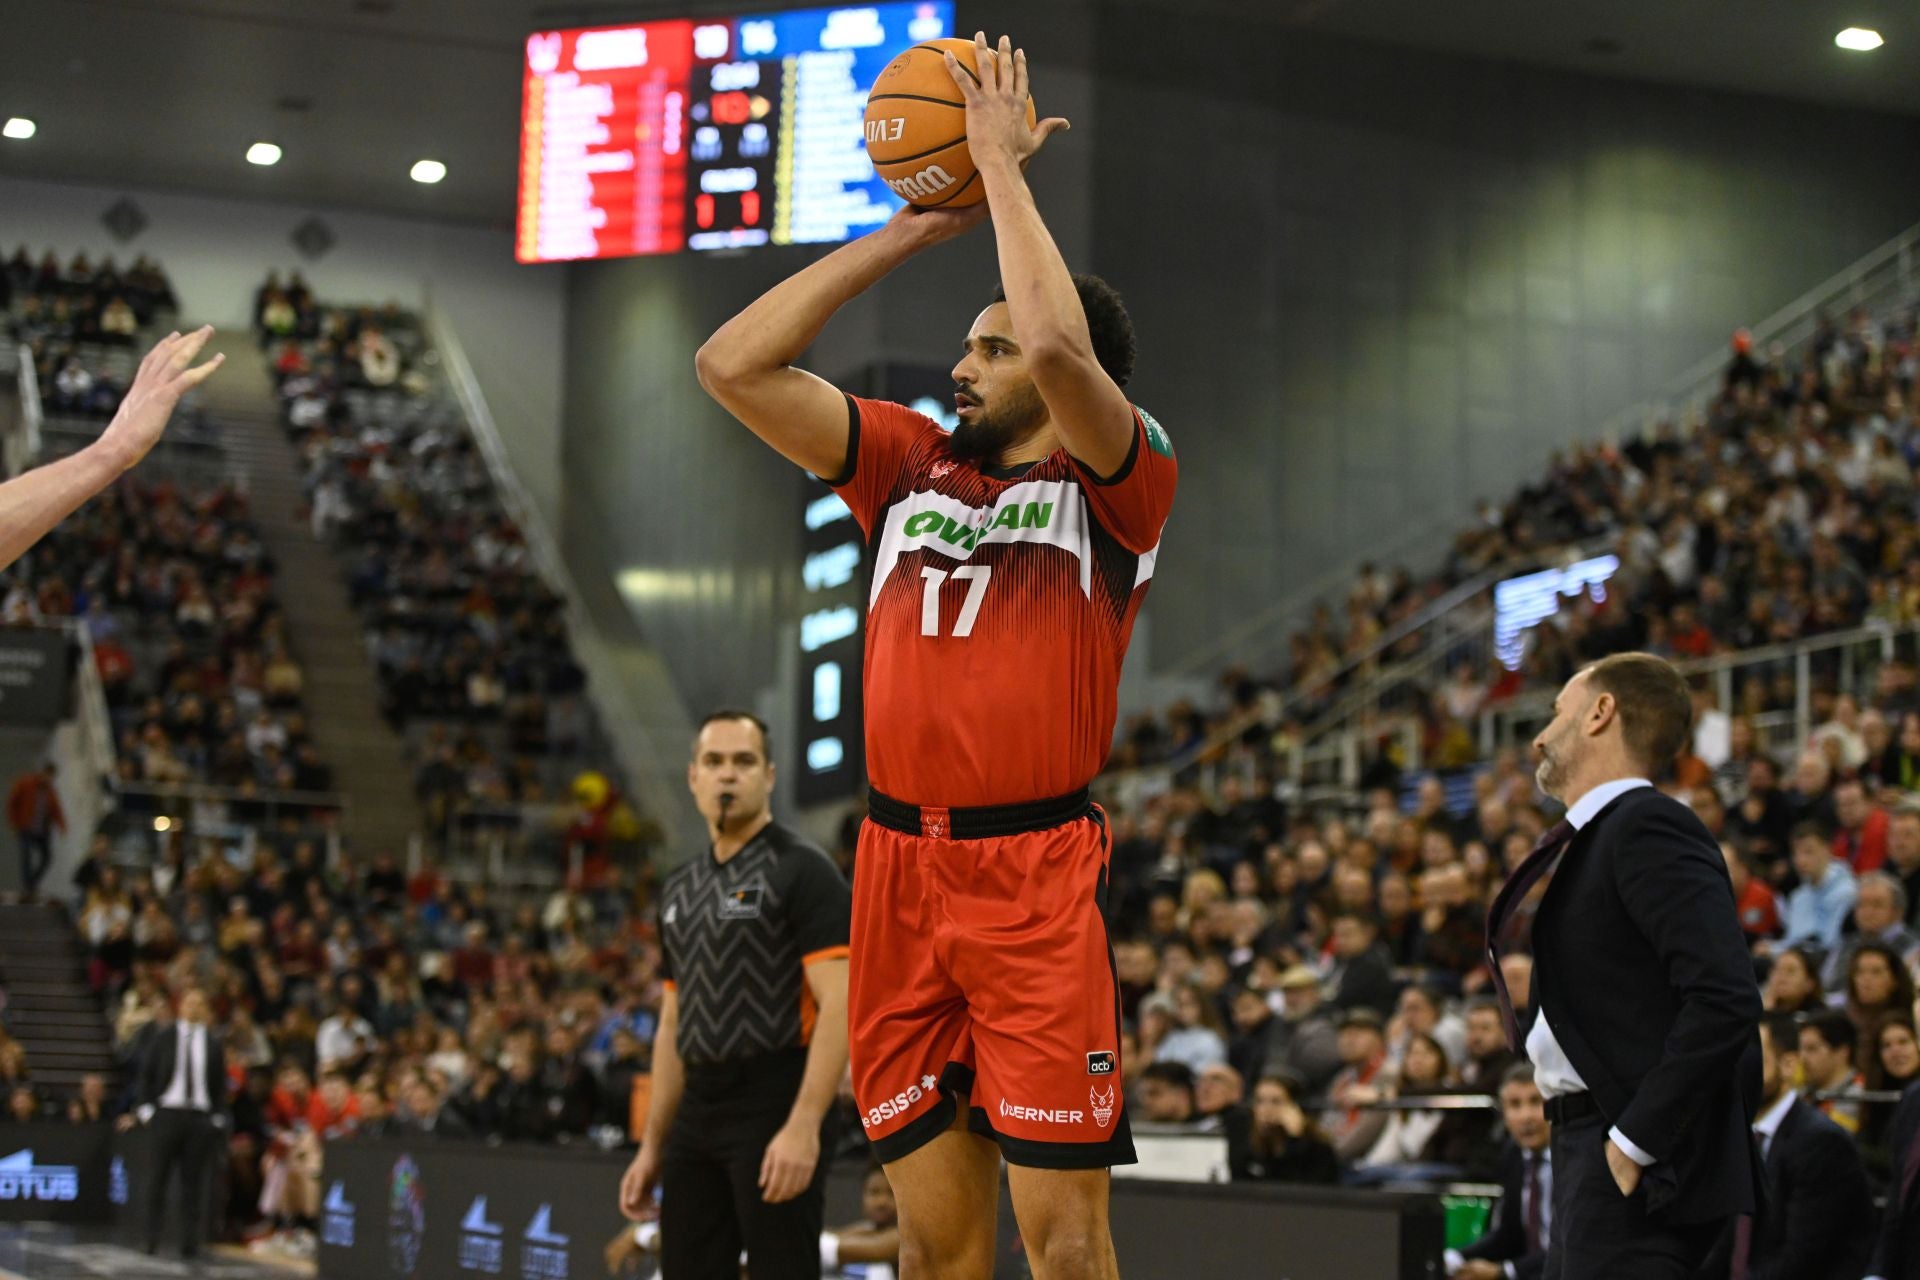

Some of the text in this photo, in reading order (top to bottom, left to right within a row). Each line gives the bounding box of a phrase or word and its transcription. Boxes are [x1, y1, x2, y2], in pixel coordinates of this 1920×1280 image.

[920, 565, 991, 637] 17
[1091, 1060, 1110, 1072] acb
[868, 1085, 923, 1126] asisa
[0, 1173, 78, 1201] OTUS
